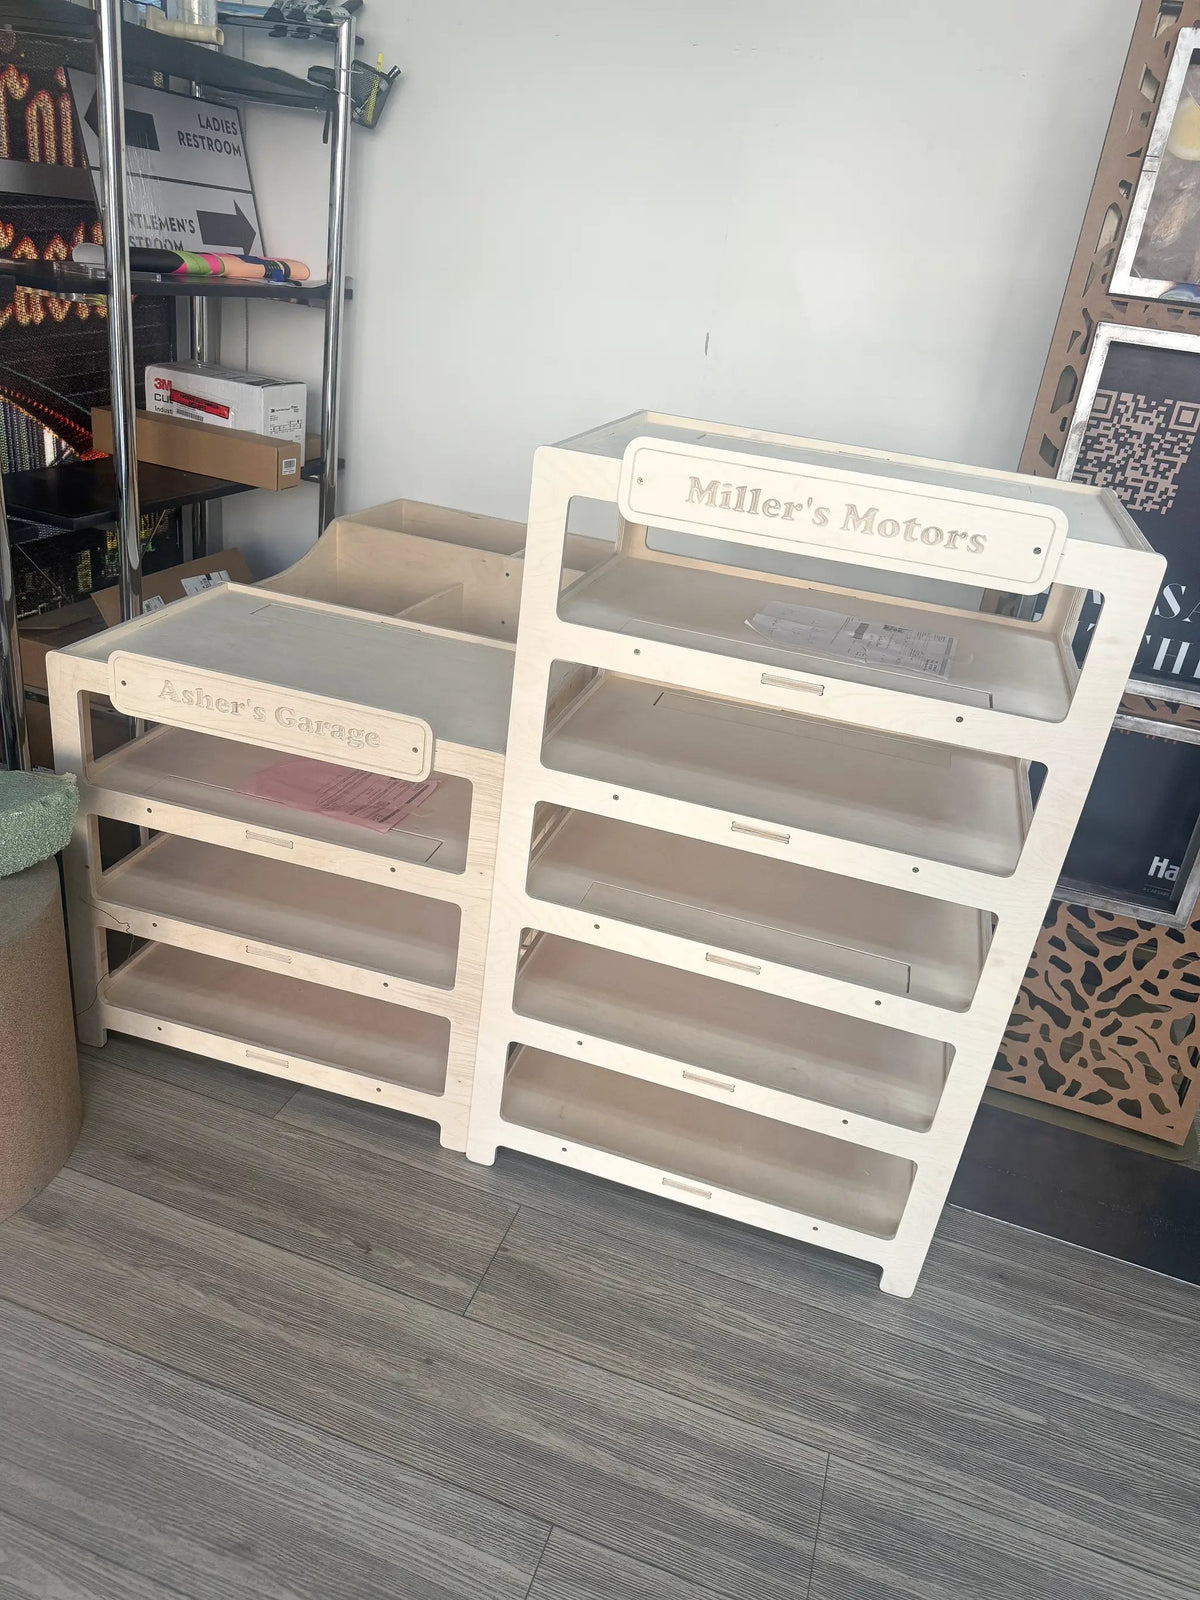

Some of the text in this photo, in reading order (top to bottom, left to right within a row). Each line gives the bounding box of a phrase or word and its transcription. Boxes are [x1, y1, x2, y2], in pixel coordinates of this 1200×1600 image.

[198, 114, 238, 136] LADIES
[177, 130, 242, 158] RESTROOM
[128, 212, 196, 235] NTLEMEN'S
[128, 236, 184, 251] STROOM
[154, 378, 172, 391] 3M
[685, 476, 988, 555] Miller's Motors
[158, 679, 381, 749] Asher's Garage
